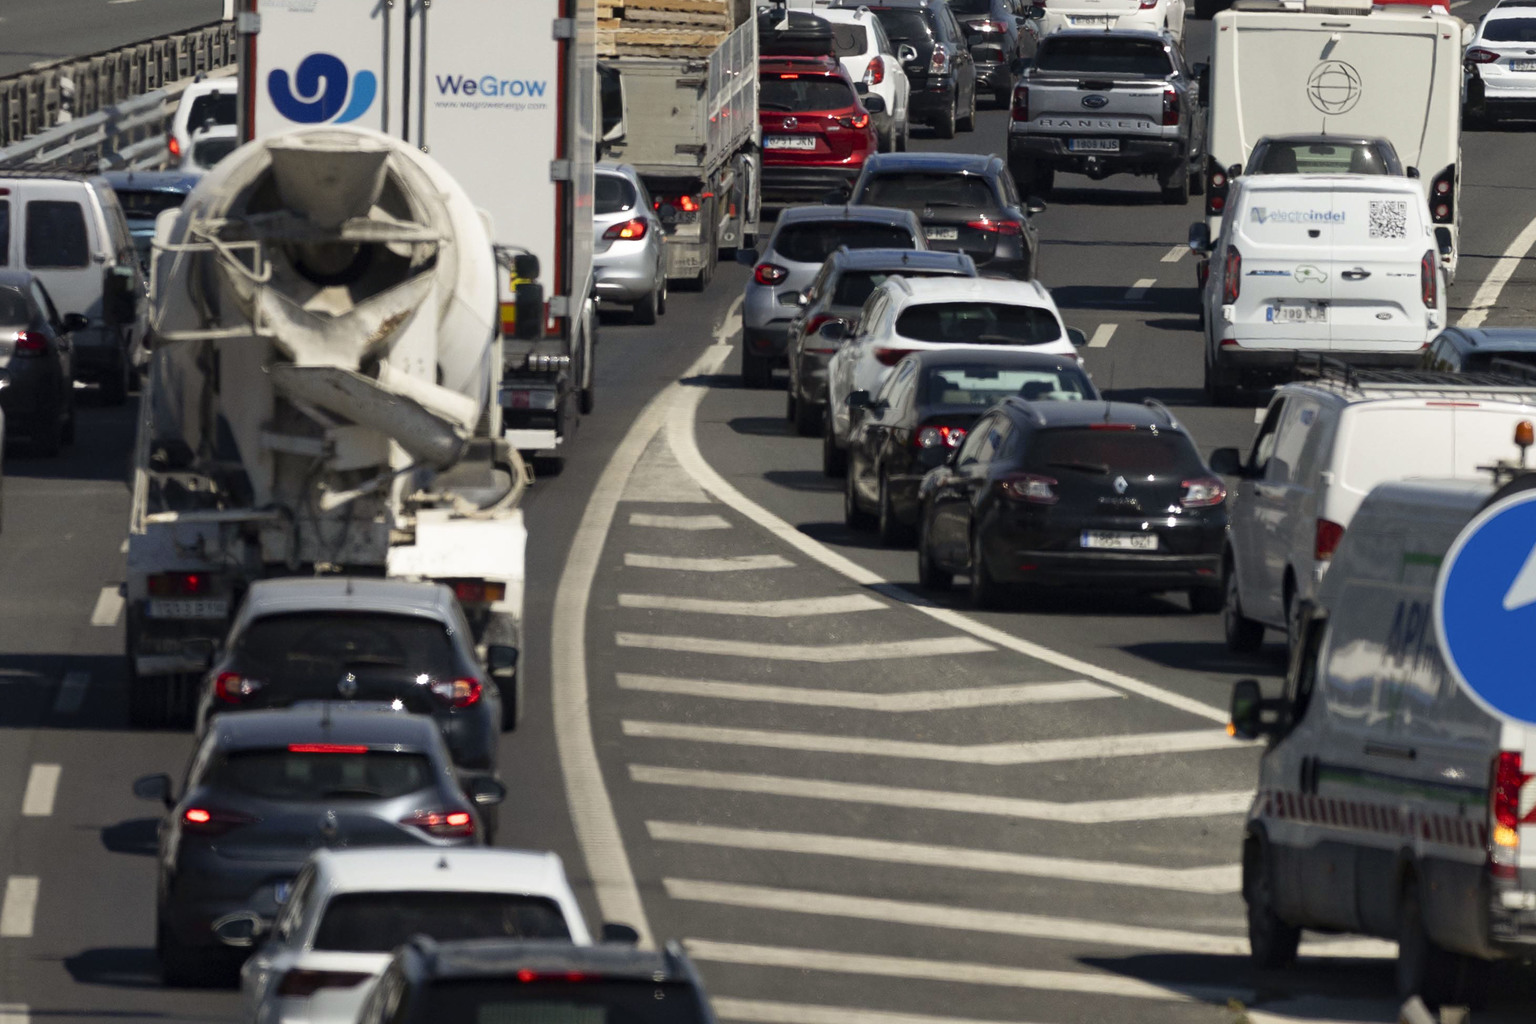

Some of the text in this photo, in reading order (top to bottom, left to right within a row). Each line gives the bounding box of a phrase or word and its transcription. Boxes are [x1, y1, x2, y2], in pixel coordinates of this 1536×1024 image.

[435, 75, 547, 97] WeGrow
[1039, 119, 1150, 129] RANGER
[1270, 209, 1346, 221] electroindel
